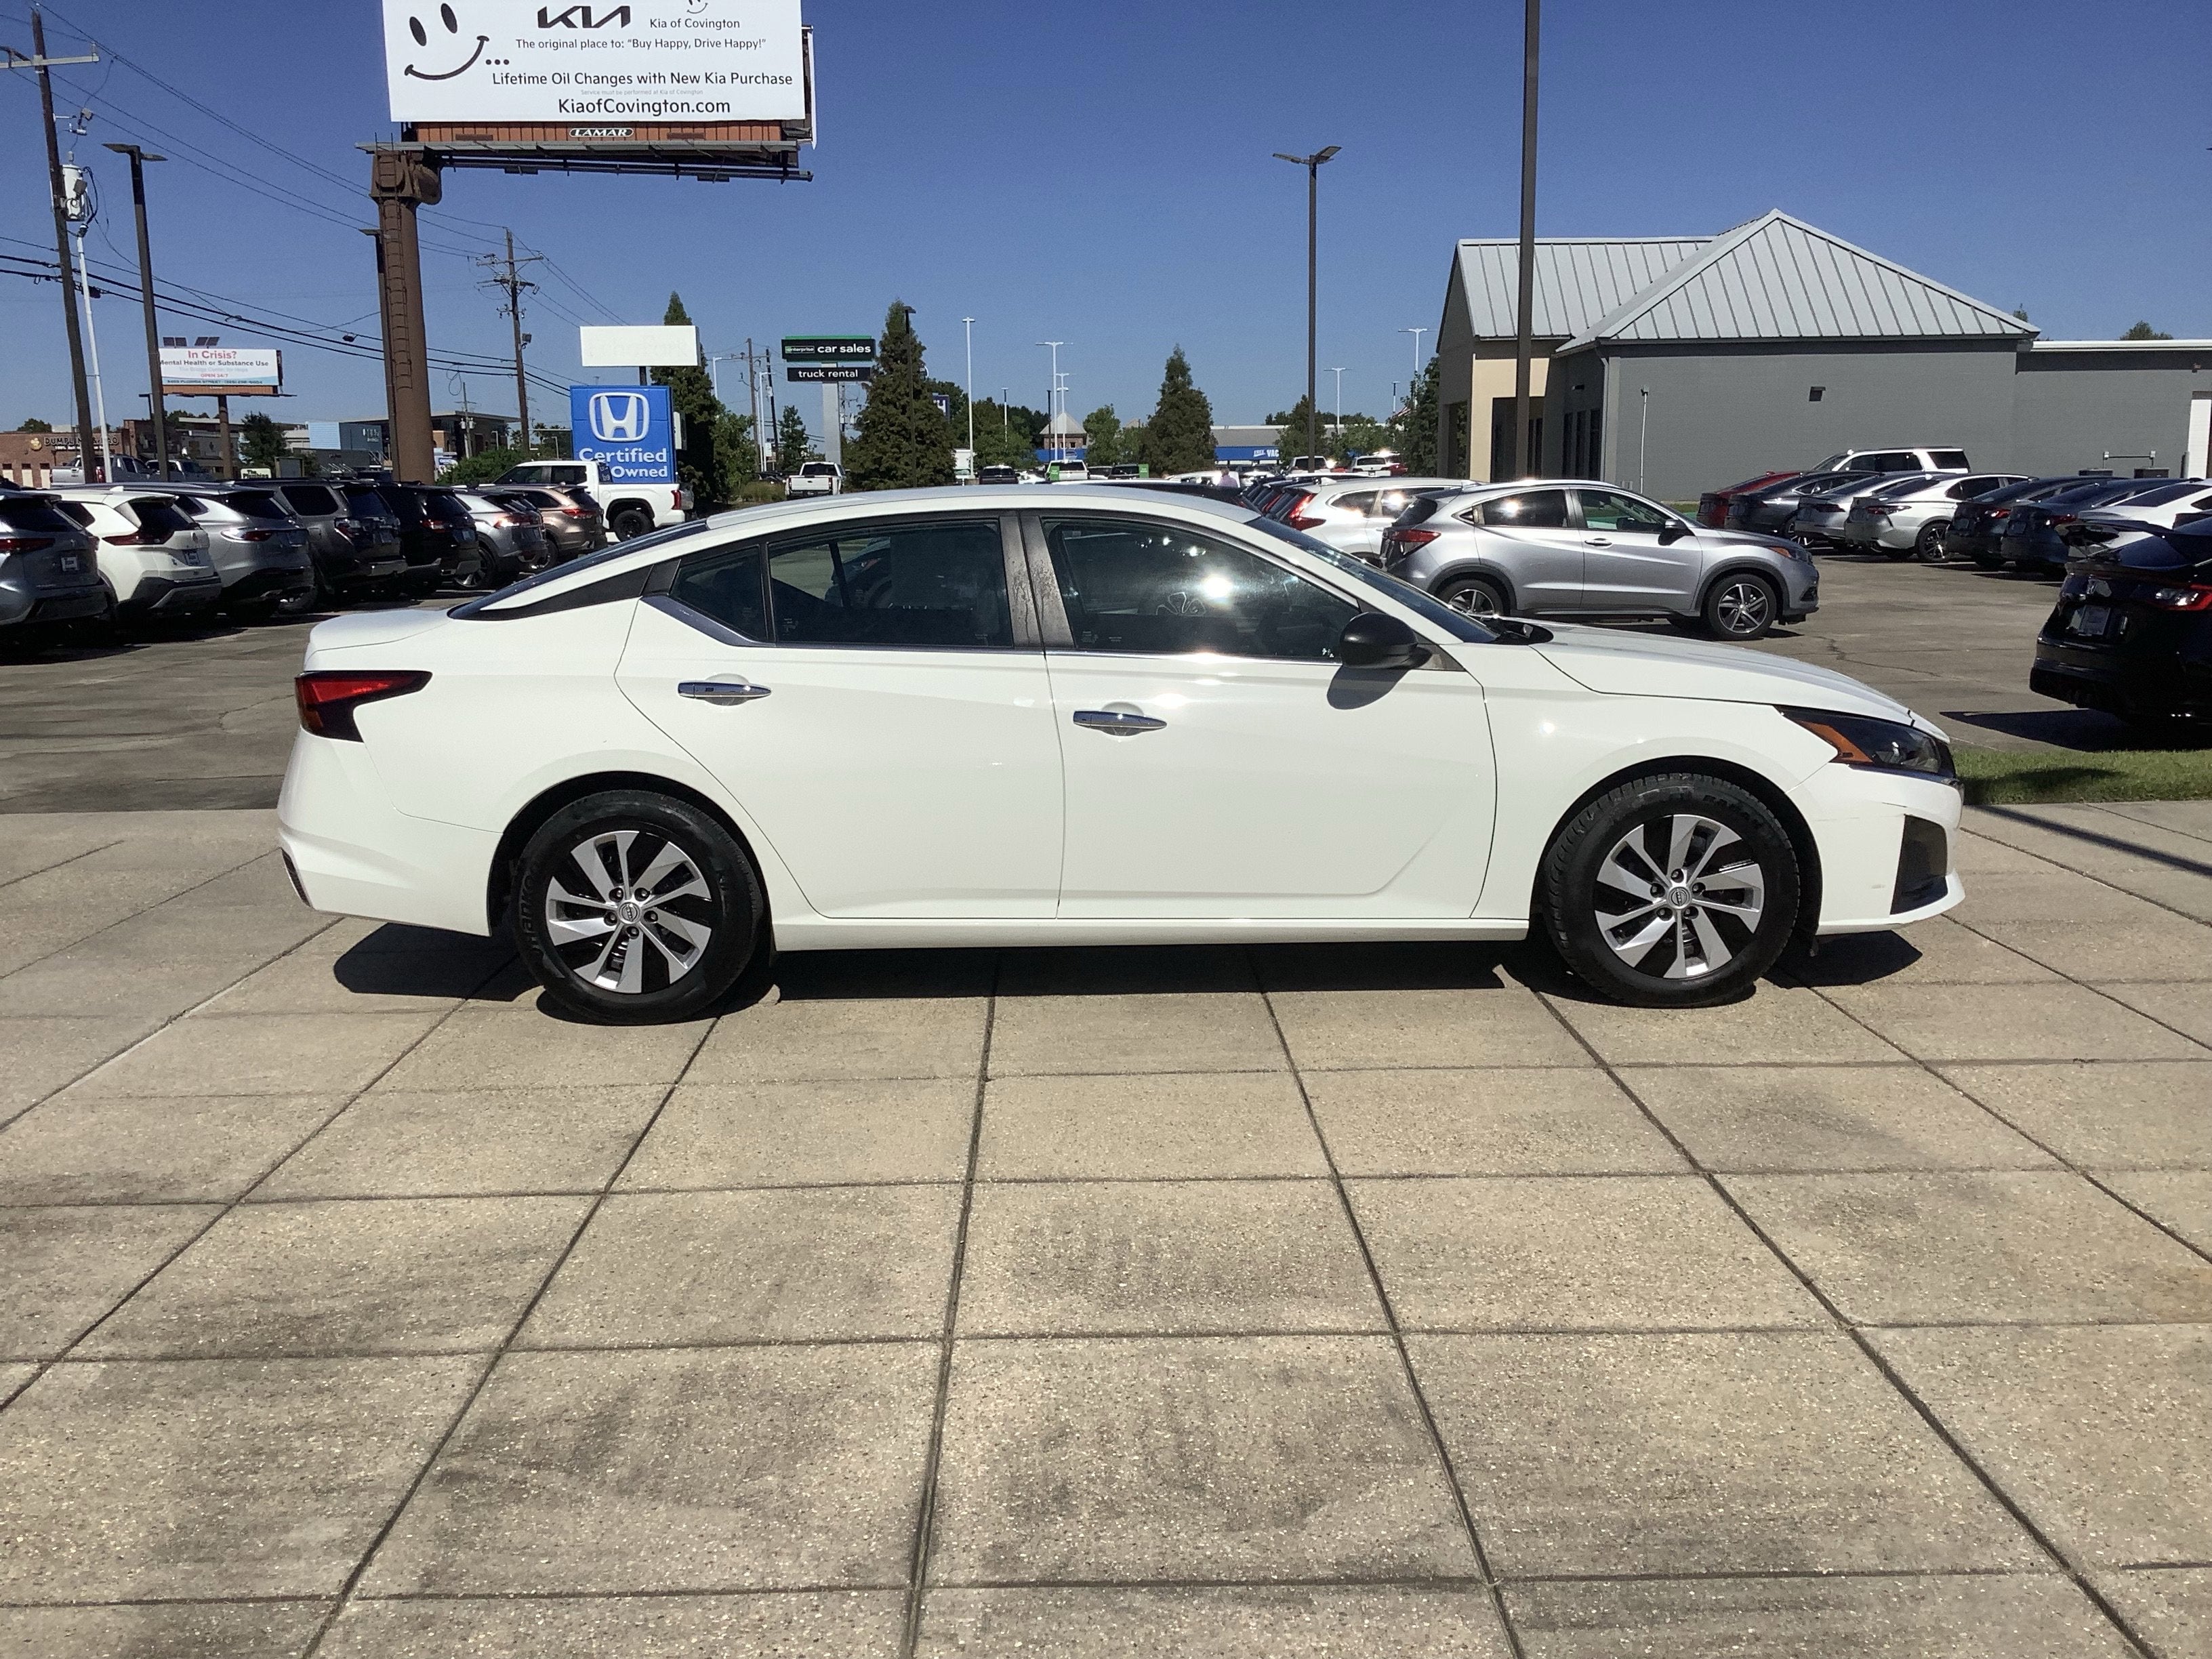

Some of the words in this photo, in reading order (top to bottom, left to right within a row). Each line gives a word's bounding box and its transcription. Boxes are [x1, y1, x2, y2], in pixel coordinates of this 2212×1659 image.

[650, 18, 668, 28] Kia
[670, 18, 682, 28] of
[684, 18, 741, 30] Covington
[516, 39, 535, 49] The
[538, 39, 577, 51] original
[580, 39, 609, 51] place
[611, 39, 625, 49] to:
[655, 39, 692, 50] Happy,
[694, 39, 722, 49] Drive
[493, 72, 548, 85] Lifetime
[552, 72, 571, 85] Oil
[575, 72, 633, 87] Changes
[637, 72, 666, 85] with
[670, 72, 701, 85] New
[705, 72, 726, 85] Kia
[731, 72, 793, 85] Purchase
[558, 98, 731, 117] KiaofCovington.com
[840, 343, 872, 353] sales
[188, 350, 198, 359] In
[202, 350, 237, 359] Crisis?
[798, 369, 825, 377] truck
[828, 369, 859, 377] rental
[579, 447, 667, 462] Certified
